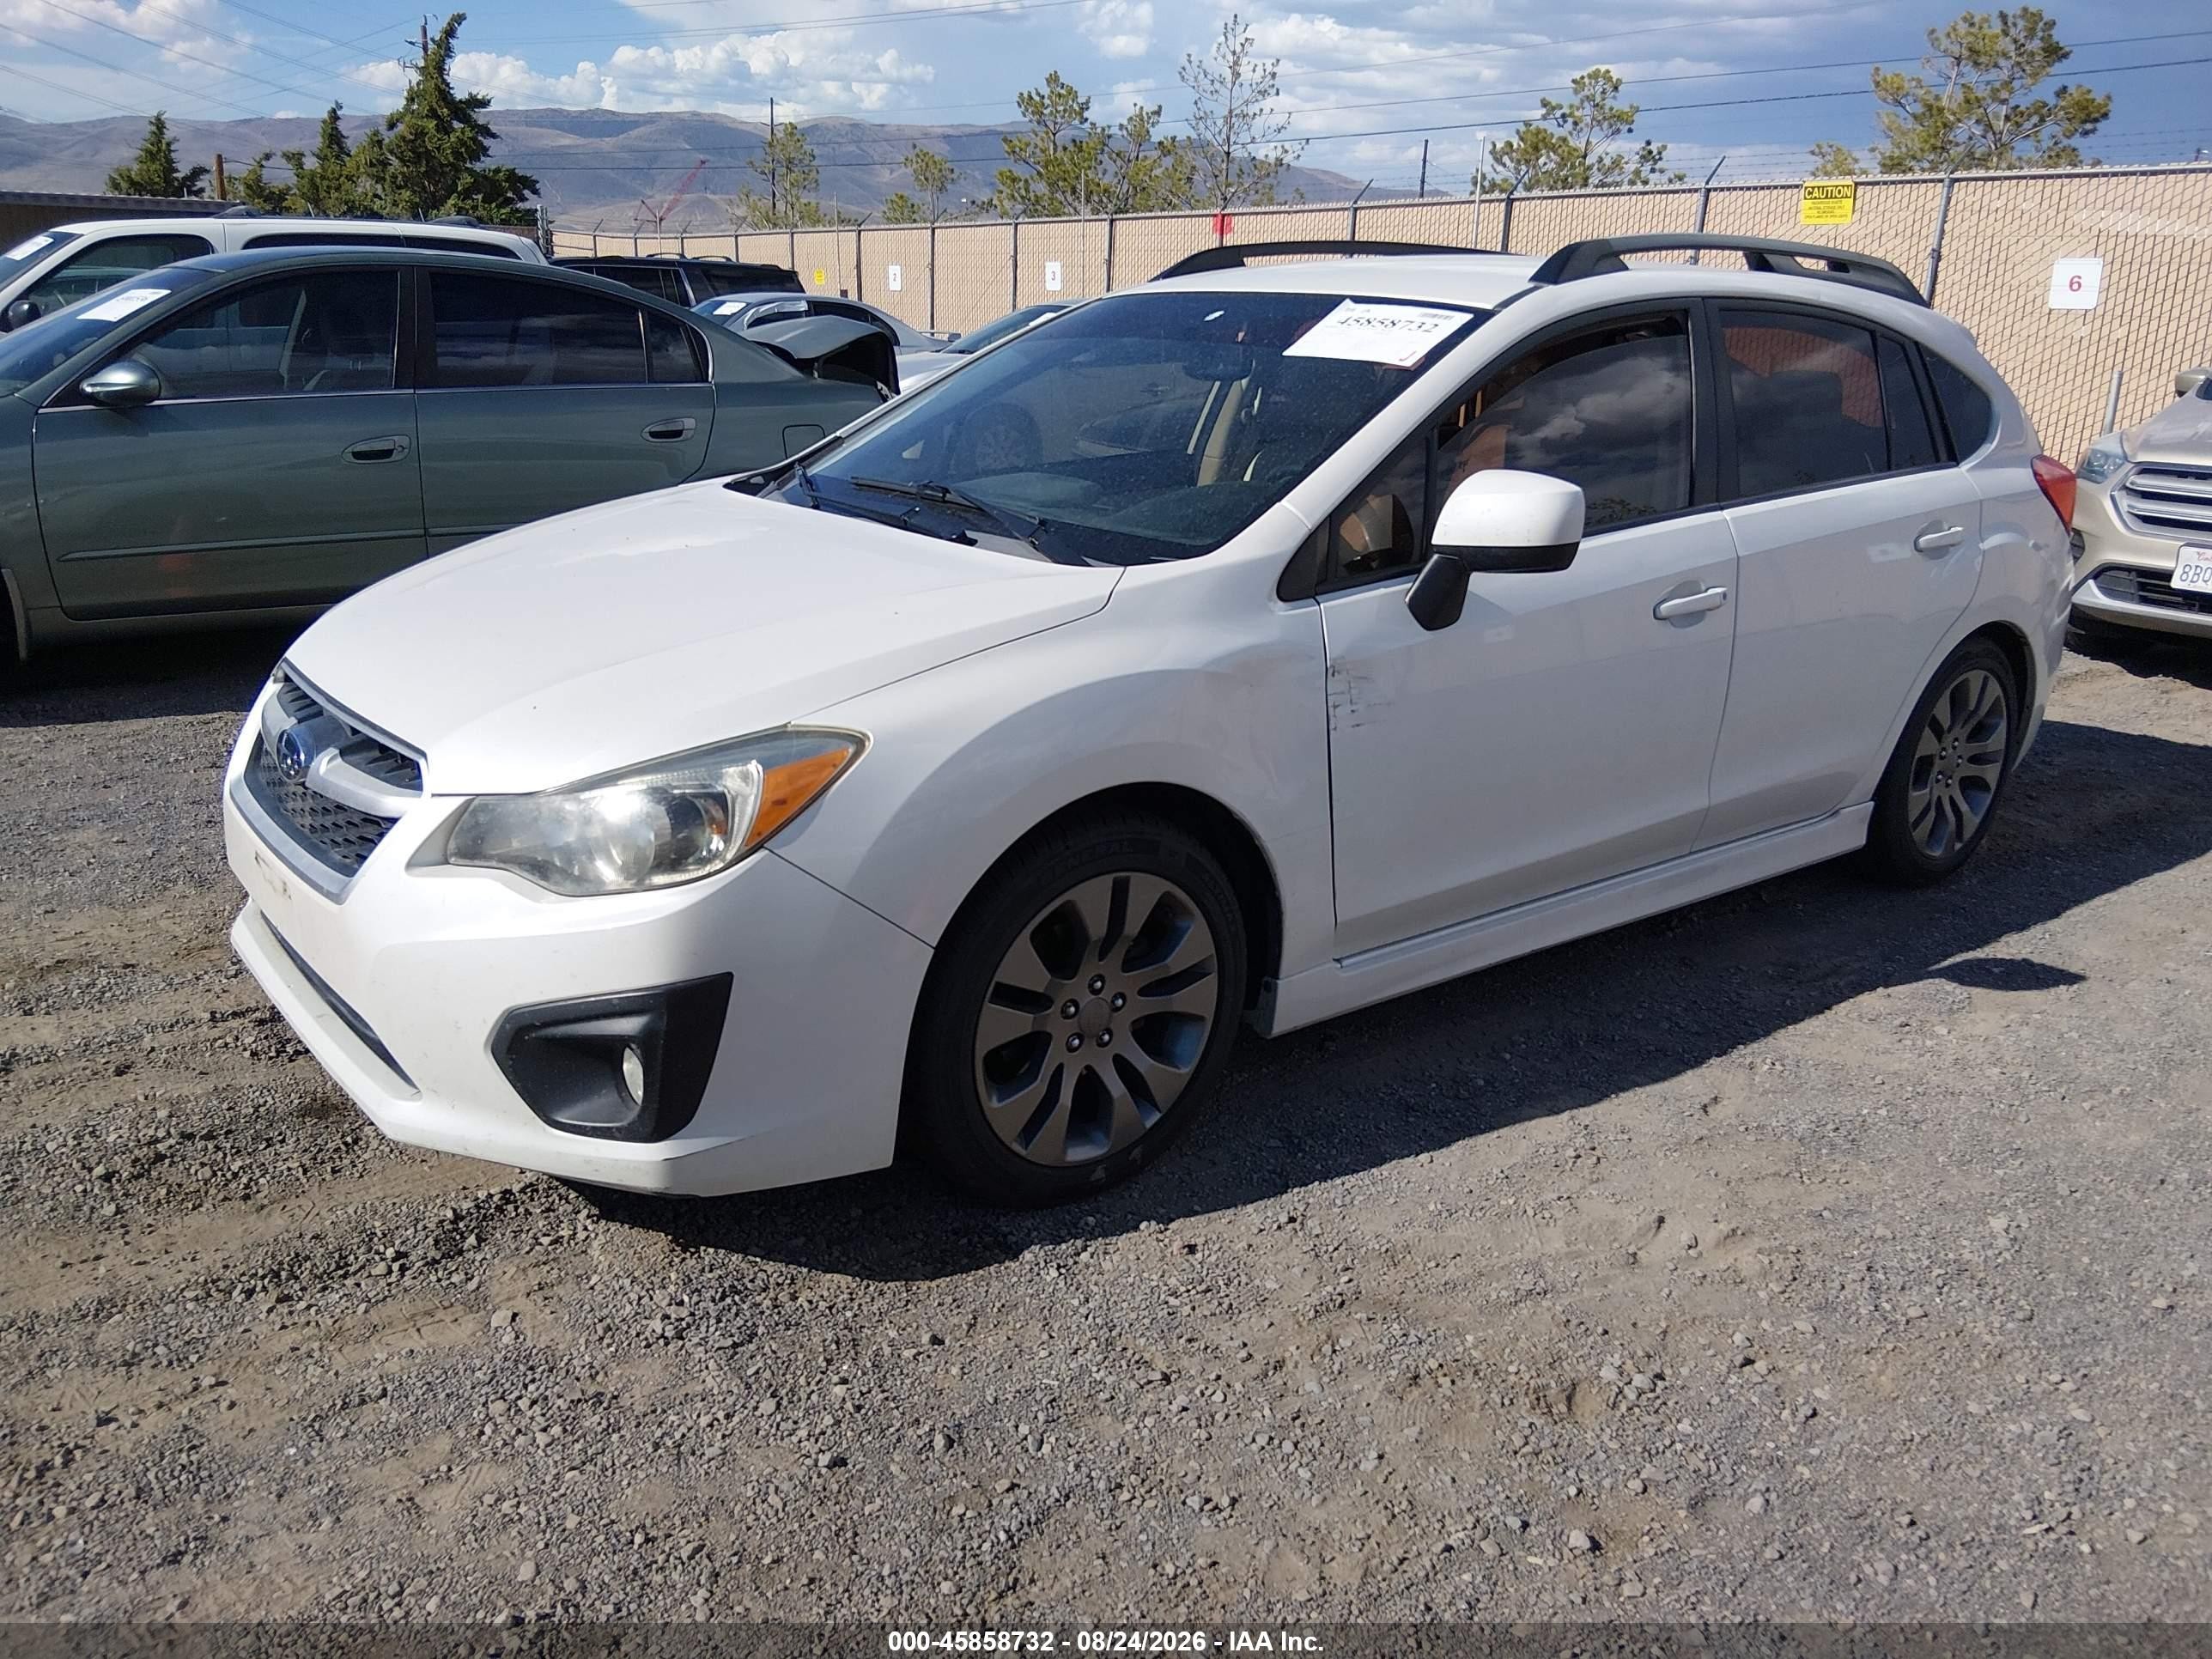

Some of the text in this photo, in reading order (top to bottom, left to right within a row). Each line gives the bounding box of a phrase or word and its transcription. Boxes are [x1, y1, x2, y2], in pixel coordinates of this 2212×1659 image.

[1805, 185, 1851, 199] CAUTION
[892, 272, 897, 282] 2
[1051, 270, 1056, 281] 3
[2069, 275, 2082, 292] 6
[1338, 315, 1440, 333] 45858732
